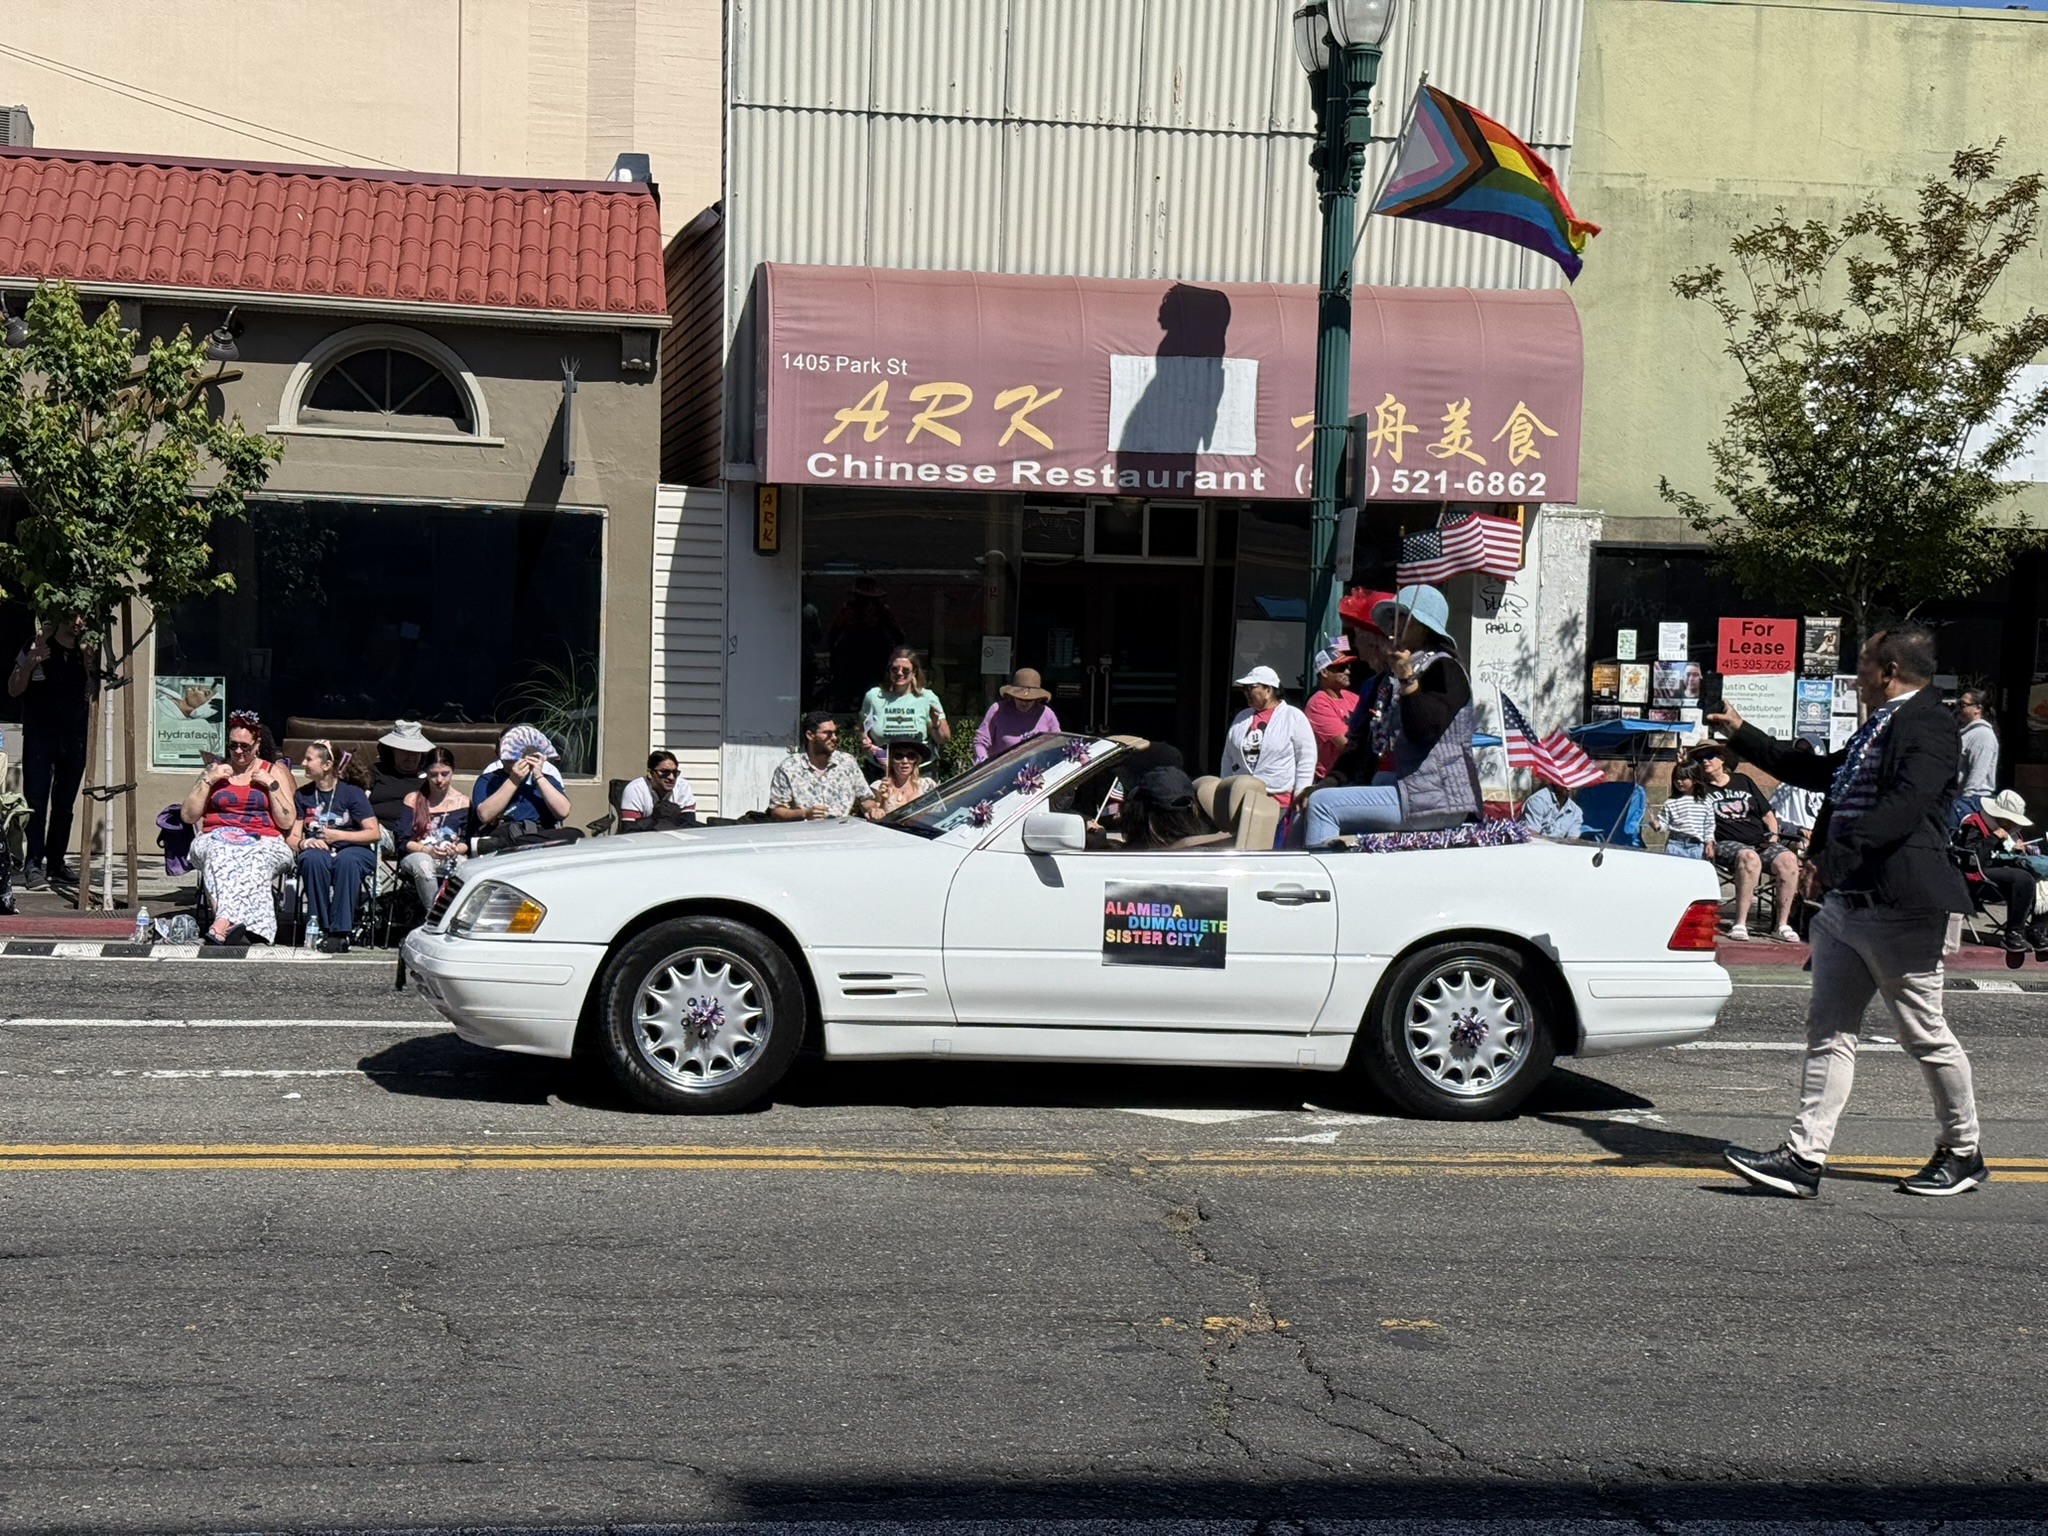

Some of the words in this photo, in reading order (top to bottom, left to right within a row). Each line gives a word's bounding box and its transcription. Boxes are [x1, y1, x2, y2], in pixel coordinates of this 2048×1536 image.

[781, 353, 830, 372] 1405
[836, 356, 881, 375] Park
[886, 358, 908, 376] St
[823, 380, 1063, 450] ARK
[806, 452, 996, 484] Chinese
[1012, 460, 1265, 491] Restaurant
[1391, 469, 1546, 497] 521-6862
[762, 493, 775, 542] ARK
[1742, 621, 1774, 637] For
[1729, 638, 1785, 655] Lease
[1722, 659, 1791, 670] 415.395.7262
[1723, 682, 1746, 691] ustin
[1737, 703, 1783, 712] Badstubner
[1777, 728, 1790, 737] JLL
[1105, 901, 1184, 918] ALAMEDA
[1128, 915, 1228, 933] DUMAGUETE
[1105, 928, 1163, 945] SISTER
[1166, 932, 1204, 947] CITY
